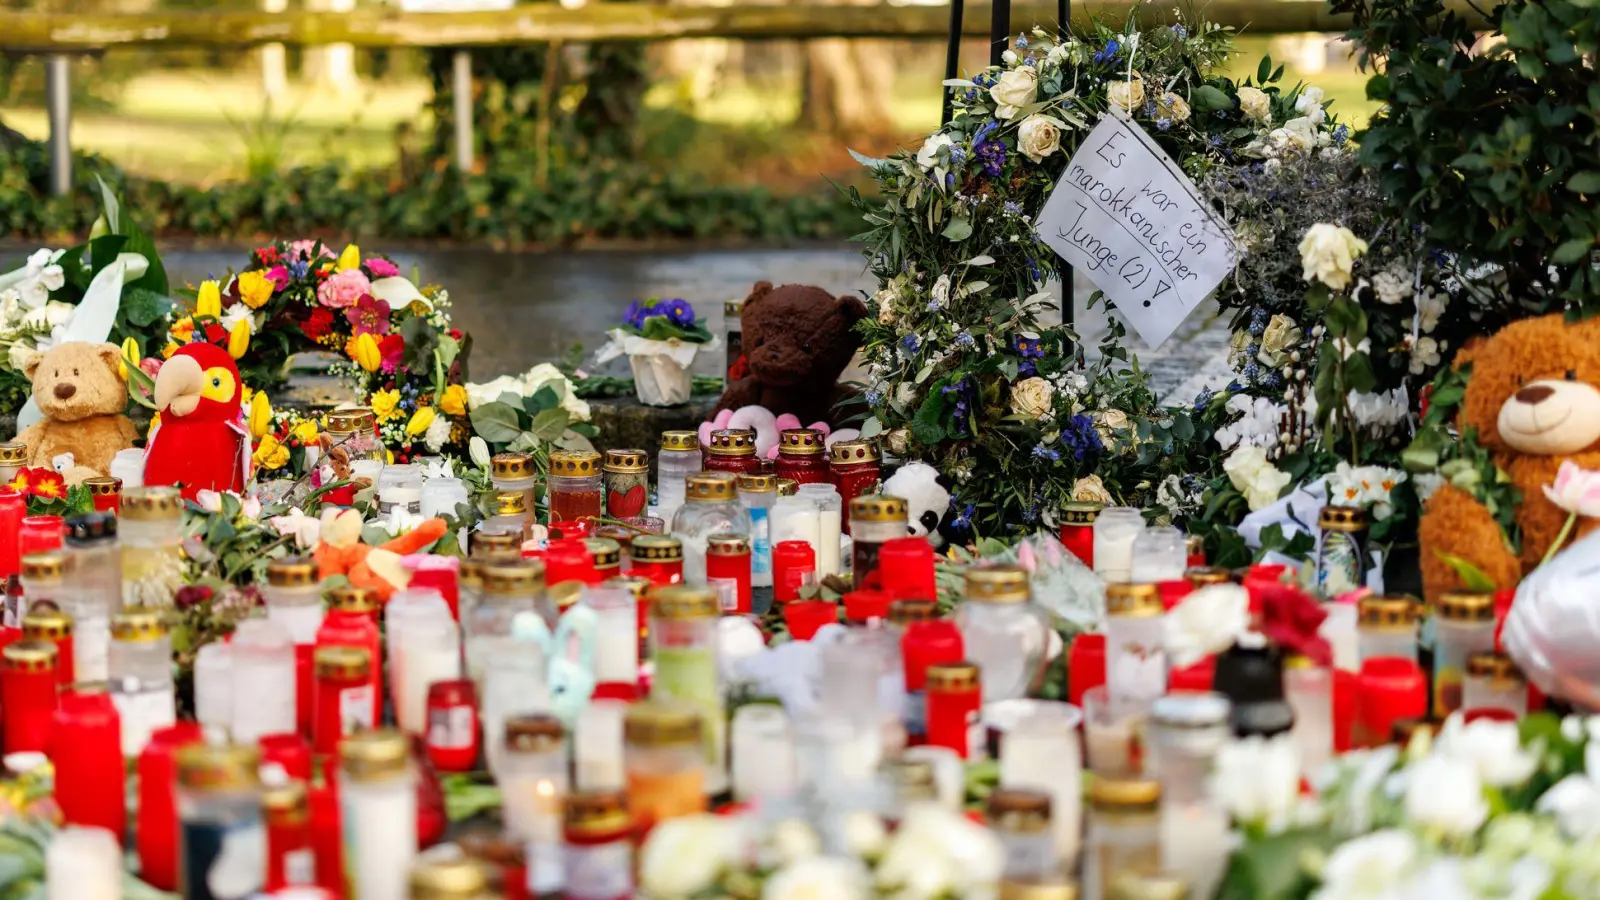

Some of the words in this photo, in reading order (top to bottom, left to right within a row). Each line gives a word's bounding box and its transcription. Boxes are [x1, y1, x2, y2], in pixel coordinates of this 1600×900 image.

[1059, 200, 1118, 271] Junge
[1069, 164, 1197, 281] marokkanischer
[1096, 131, 1126, 168] Es
[1141, 180, 1178, 212] war
[1179, 222, 1207, 255] ein
